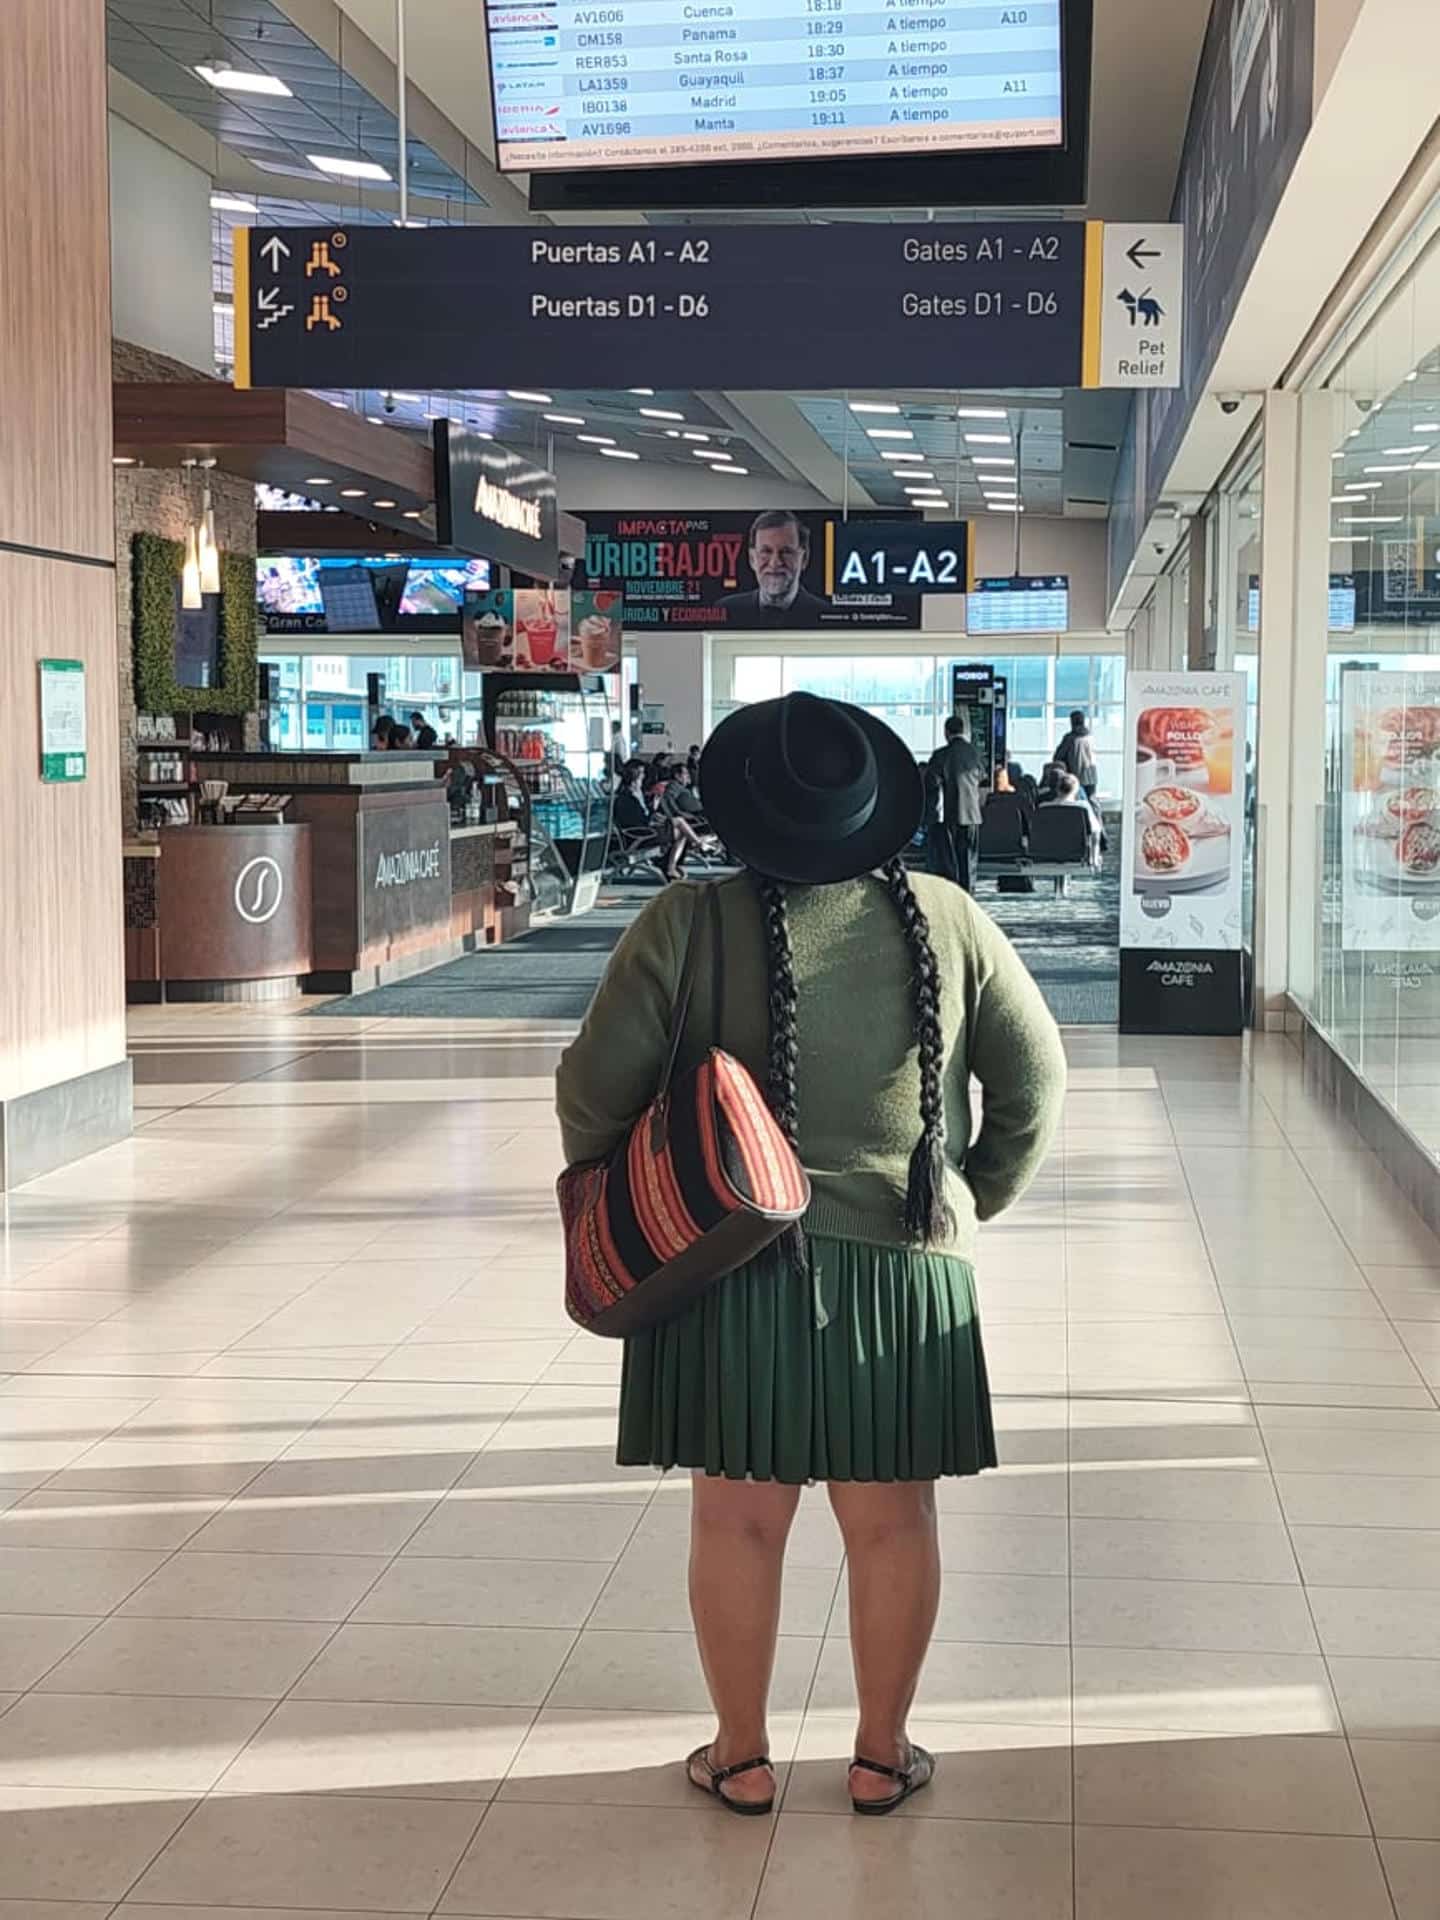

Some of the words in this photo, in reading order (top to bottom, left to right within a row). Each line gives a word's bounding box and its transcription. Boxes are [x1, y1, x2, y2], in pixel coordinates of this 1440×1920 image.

[574, 11, 624, 24] AV1606
[683, 5, 733, 19] Cuenca
[578, 33, 623, 46] CM158
[682, 28, 736, 41] Panama
[807, 22, 843, 35] 18:29
[887, 18, 898, 30] A
[900, 18, 946, 32] tiempo
[1001, 11, 1028, 24] A10
[576, 55, 628, 69] RER853
[674, 52, 711, 65] Santa
[715, 49, 748, 62] Rosa
[808, 44, 845, 58] 18:30
[888, 41, 898, 53] A
[900, 40, 947, 55] tiempo
[579, 78, 628, 92] LA1359
[679, 71, 745, 88] Guayaquil
[808, 66, 845, 80] 18:37
[888, 64, 899, 76] A
[901, 63, 948, 78] tiempo
[582, 101, 627, 114] IB0138
[691, 95, 736, 108] Madrid
[810, 90, 846, 103] 19:05
[889, 86, 899, 99] A
[901, 85, 948, 100] tiempo
[1003, 80, 1027, 93] A11
[695, 117, 735, 130] Manta
[812, 111, 846, 125] 19:11
[890, 109, 900, 121] A
[903, 107, 949, 123] tiempo
[532, 241, 621, 263] Puertas
[628, 241, 655, 263] A1
[679, 241, 709, 263] A2
[903, 238, 968, 261] Gates
[976, 238, 1003, 261] A1
[1029, 237, 1059, 260] A2
[532, 295, 620, 317] Puertas
[628, 295, 655, 317] D1
[679, 295, 709, 317] D6
[902, 293, 967, 316] Gates
[975, 292, 1002, 315] D1
[1027, 292, 1058, 315] D6
[1139, 340, 1165, 355] Pet
[1118, 360, 1165, 375] Relief
[840, 551, 957, 585] A1-A2
[625, 580, 684, 595] NOVIEMBRE
[269, 616, 303, 629] Gran
[305, 615, 327, 628] Co
[623, 607, 659, 622] RIDAD
[662, 607, 669, 622] Y
